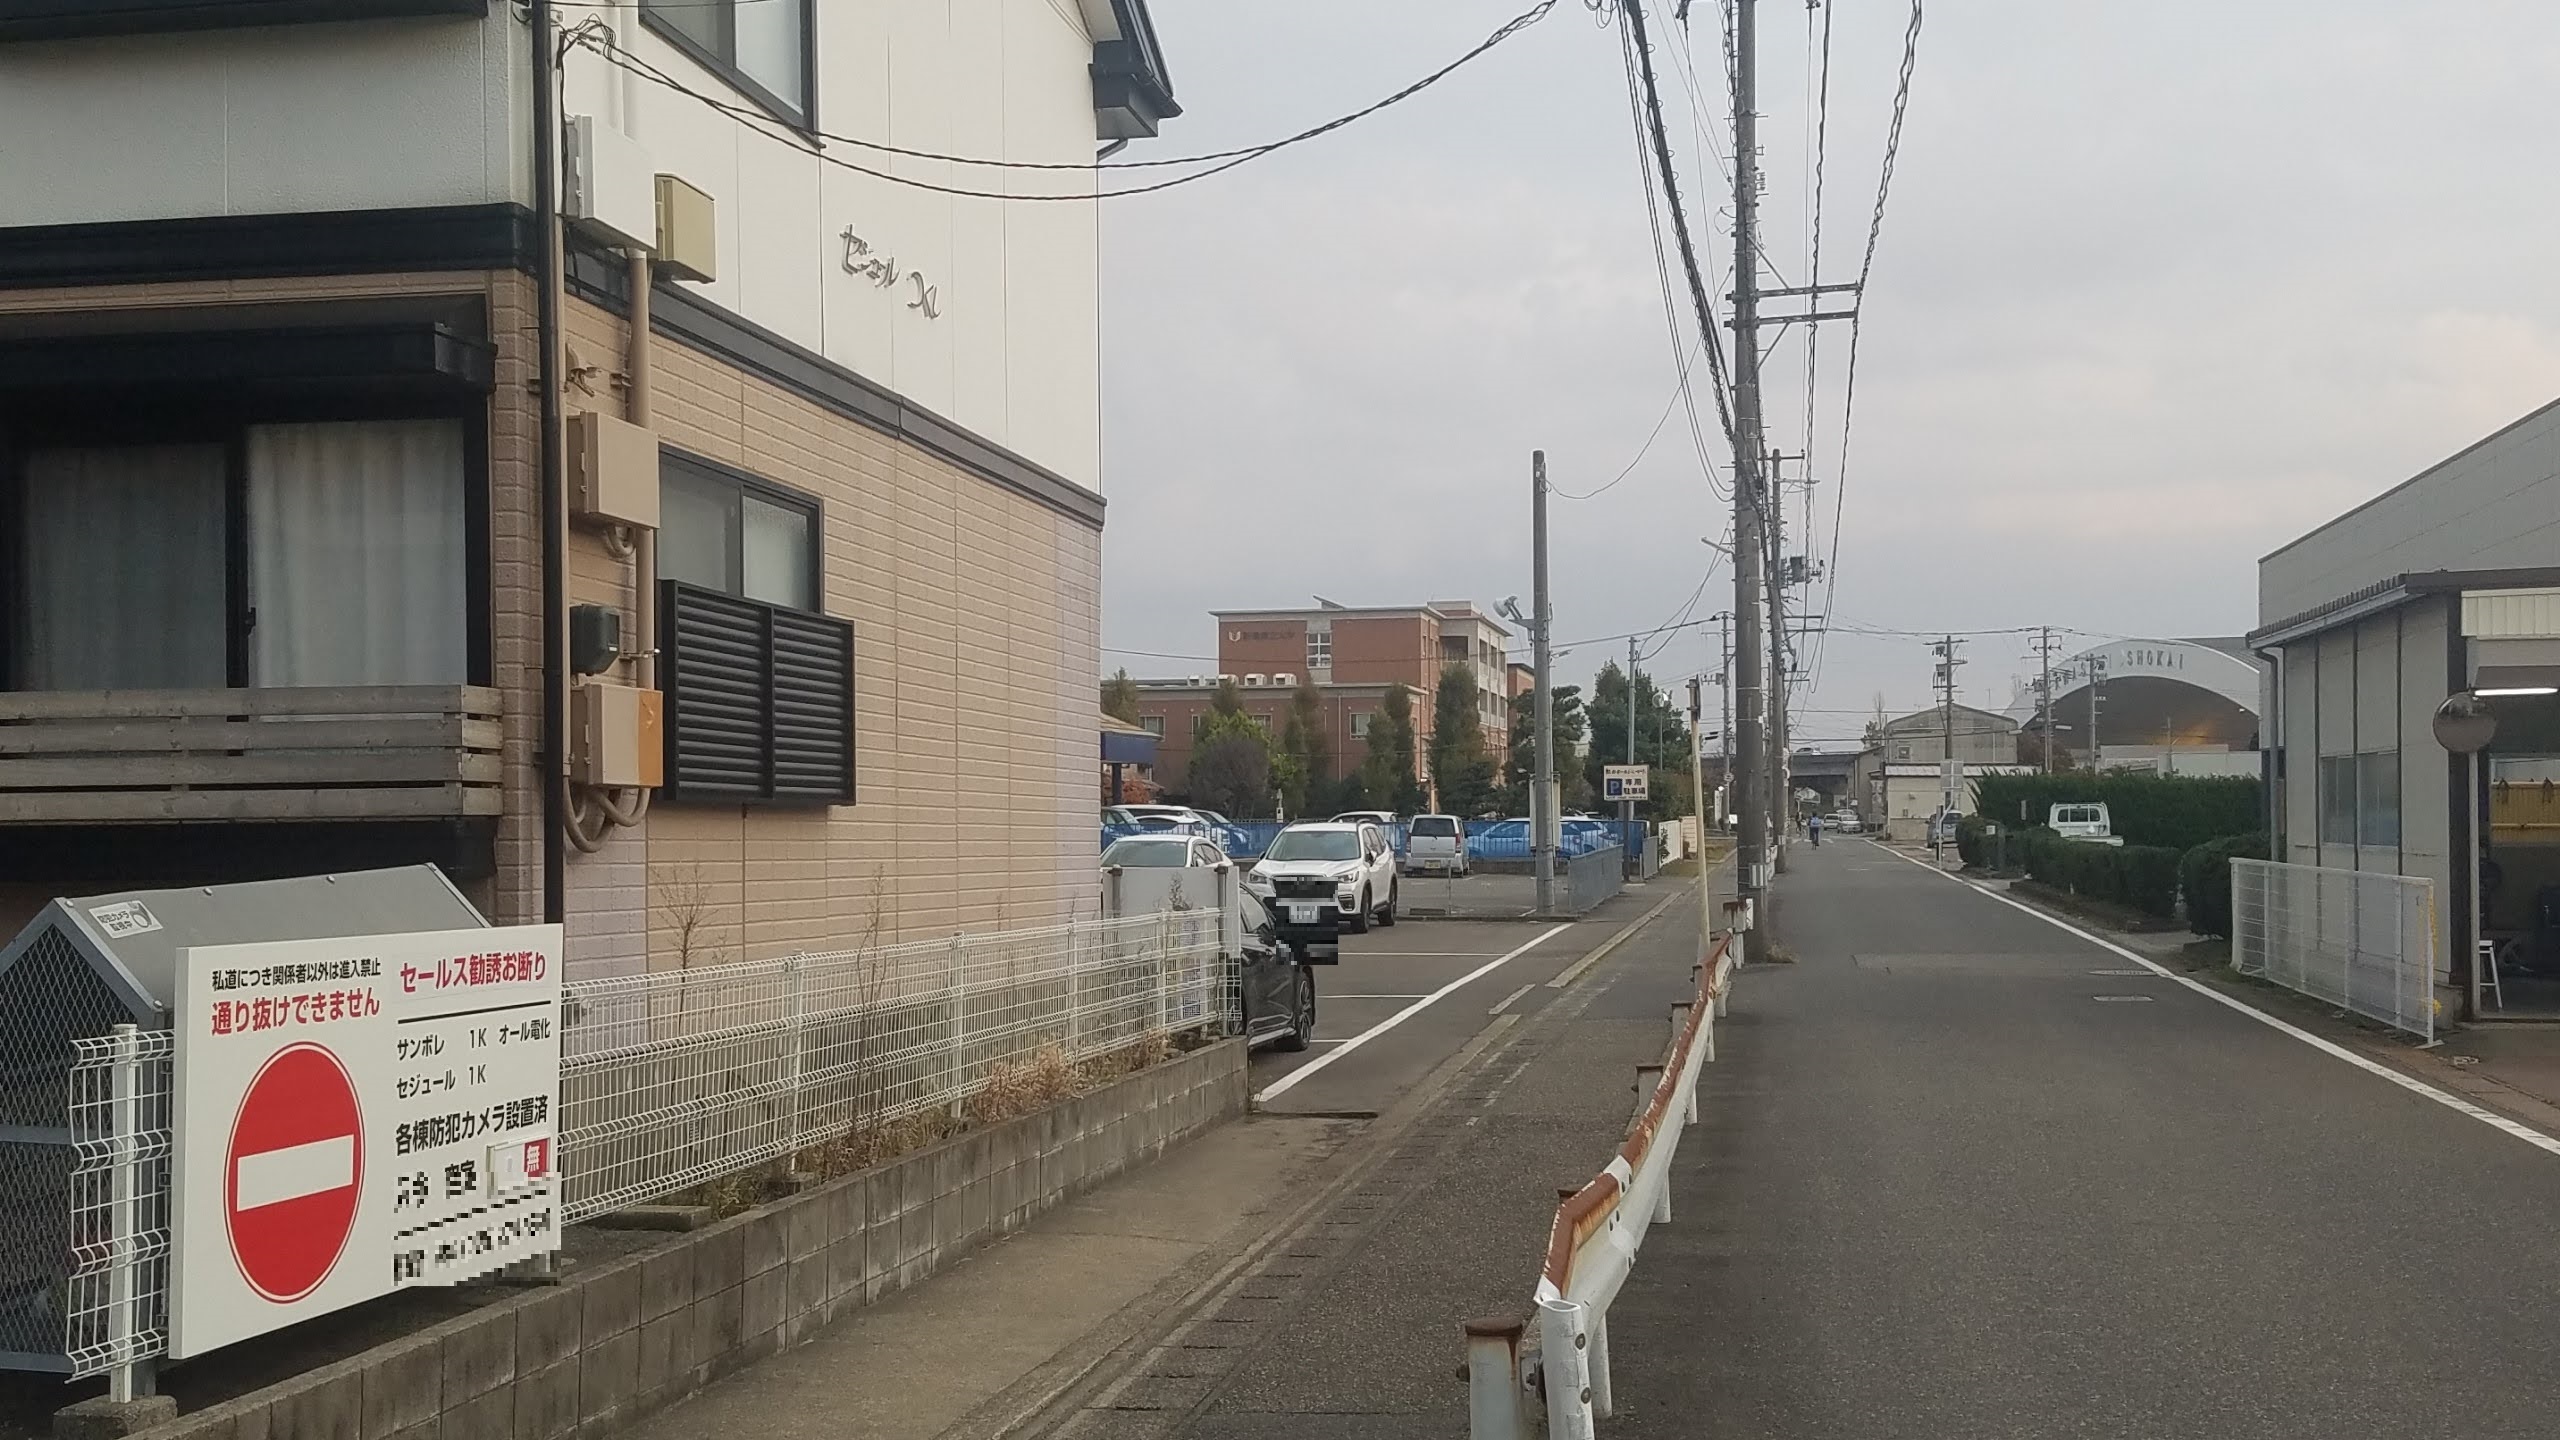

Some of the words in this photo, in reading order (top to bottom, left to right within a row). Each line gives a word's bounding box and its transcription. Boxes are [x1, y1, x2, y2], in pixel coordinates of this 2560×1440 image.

[2127, 650, 2184, 670] SHOKAI
[1611, 781, 1619, 793] P
[1623, 787, 1646, 795] 駐車場
[212, 957, 381, 991] 私道につき関係者以外は進入禁止
[400, 951, 546, 993] セールス勧誘お断り
[212, 987, 380, 1036] 通り抜けできません
[470, 1028, 487, 1048] 1K
[499, 1018, 550, 1045] オール電化
[397, 1069, 456, 1099] セジュール
[469, 1064, 487, 1085] 1K
[396, 1094, 549, 1156] 各棟防犯カメラ設置済
[526, 1144, 541, 1173] 無
